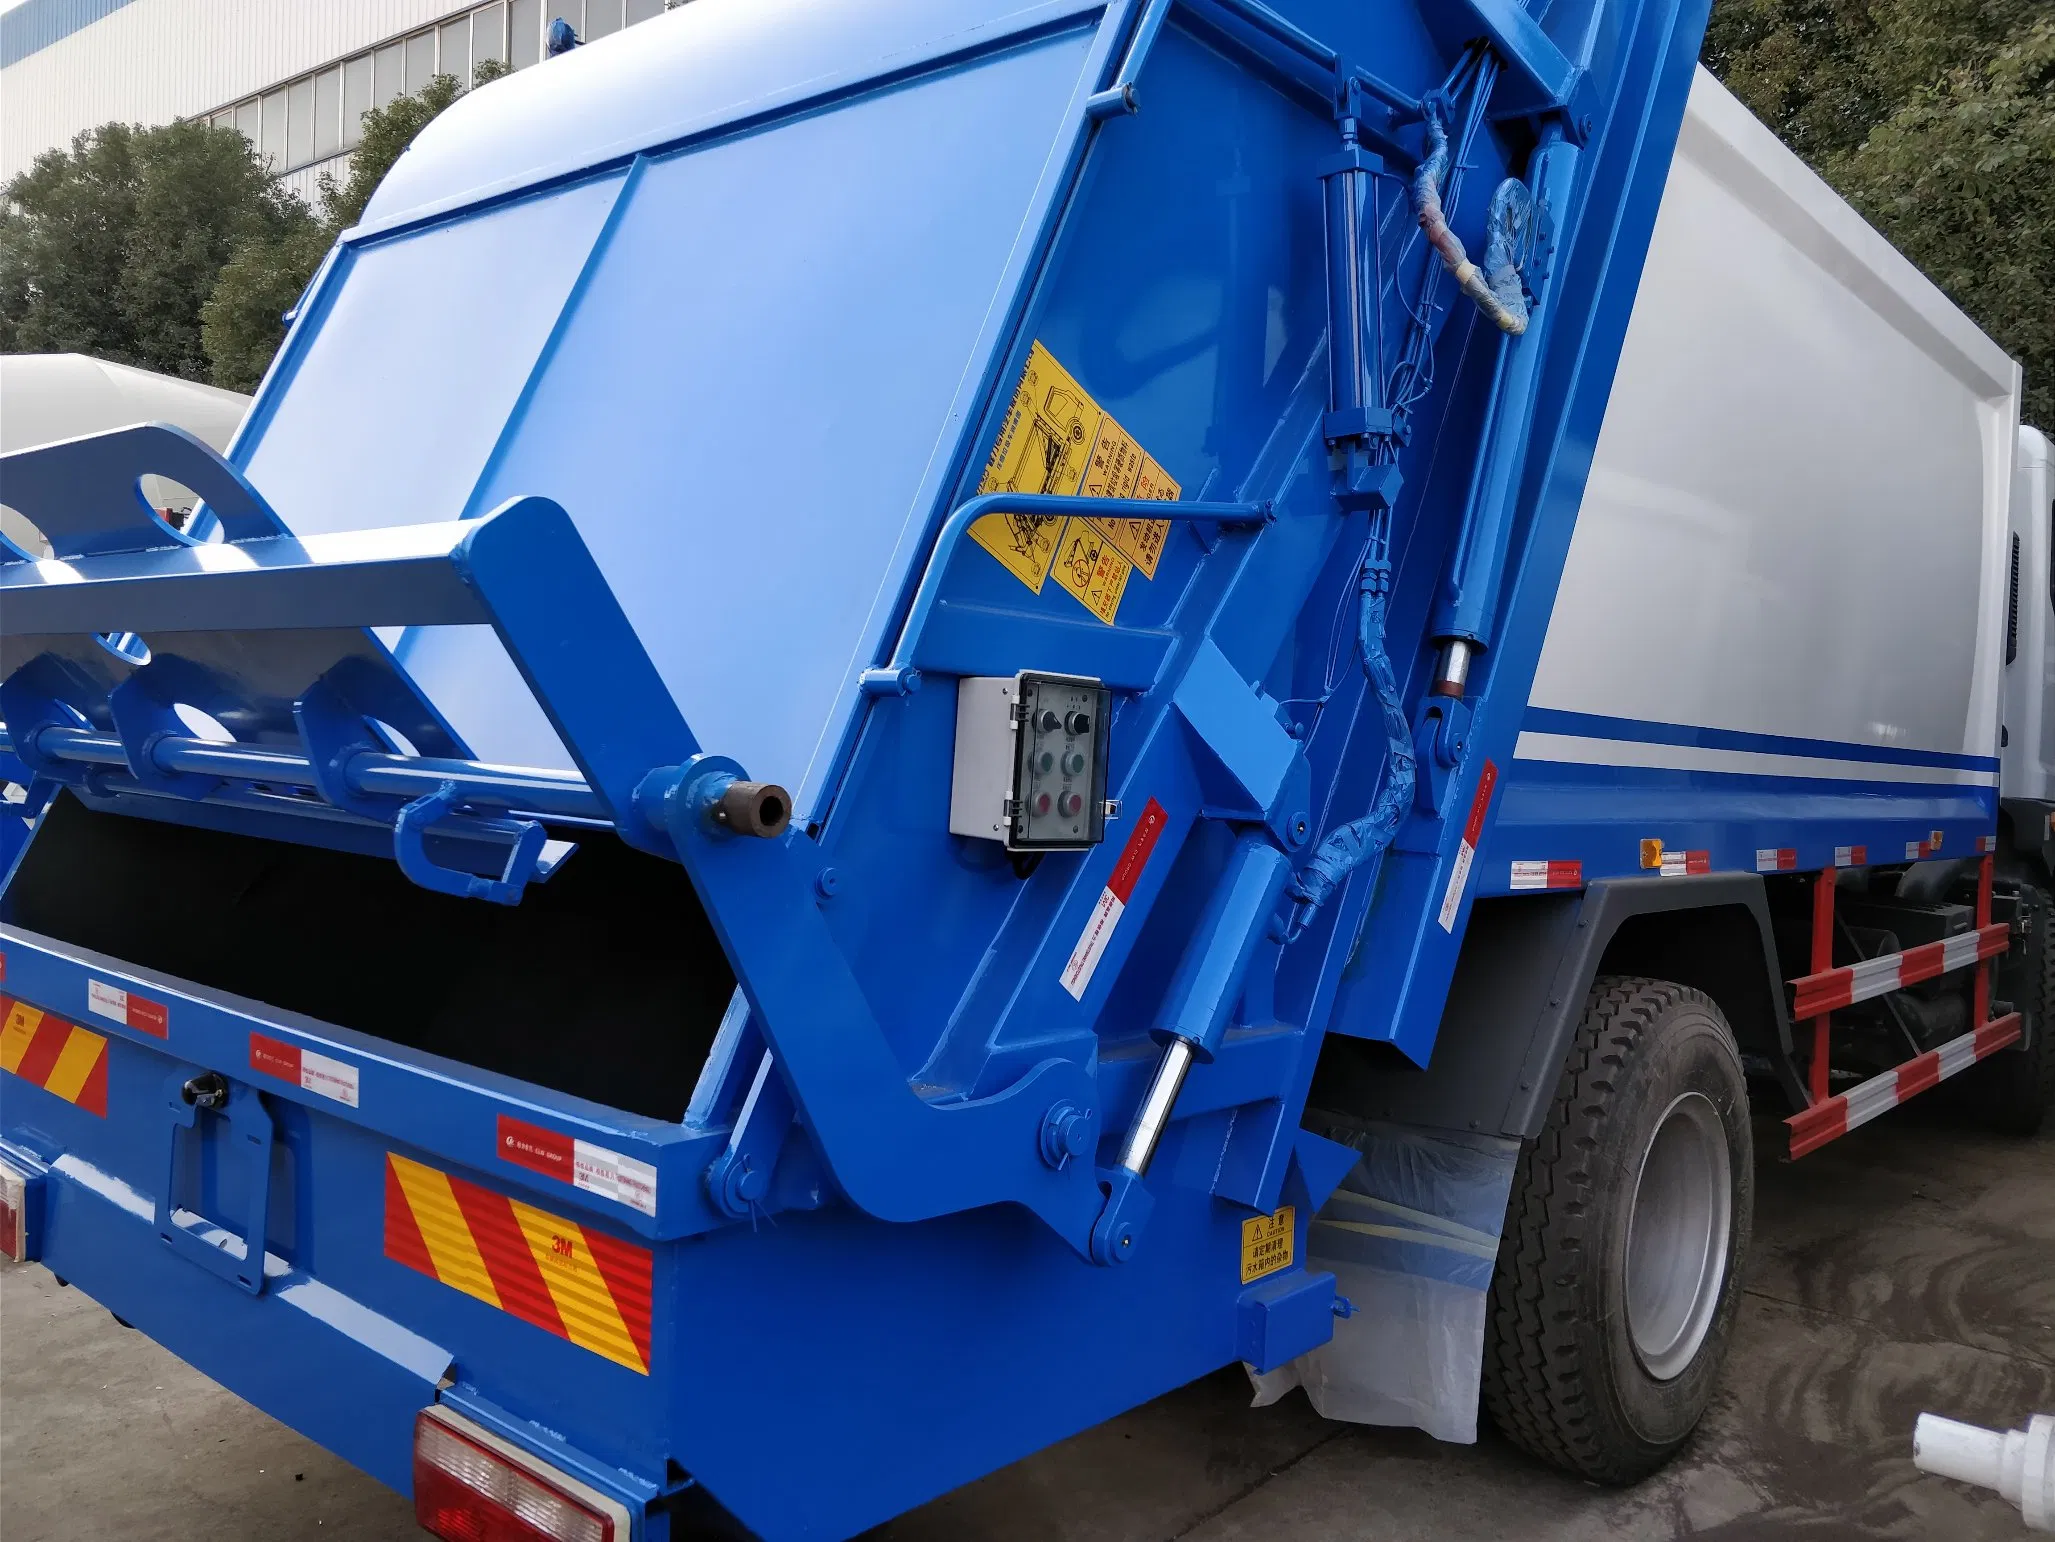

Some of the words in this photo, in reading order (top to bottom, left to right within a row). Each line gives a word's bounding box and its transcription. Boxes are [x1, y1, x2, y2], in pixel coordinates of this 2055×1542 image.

[1102, 440, 1117, 477] WARNING
[1108, 518, 1117, 530] No
[1121, 473, 1131, 492] rigid
[1127, 453, 1137, 473] waste
[1103, 557, 1114, 586] WARNING
[1266, 1226, 1285, 1237] CAUTION
[551, 1235, 573, 1258] 3M
